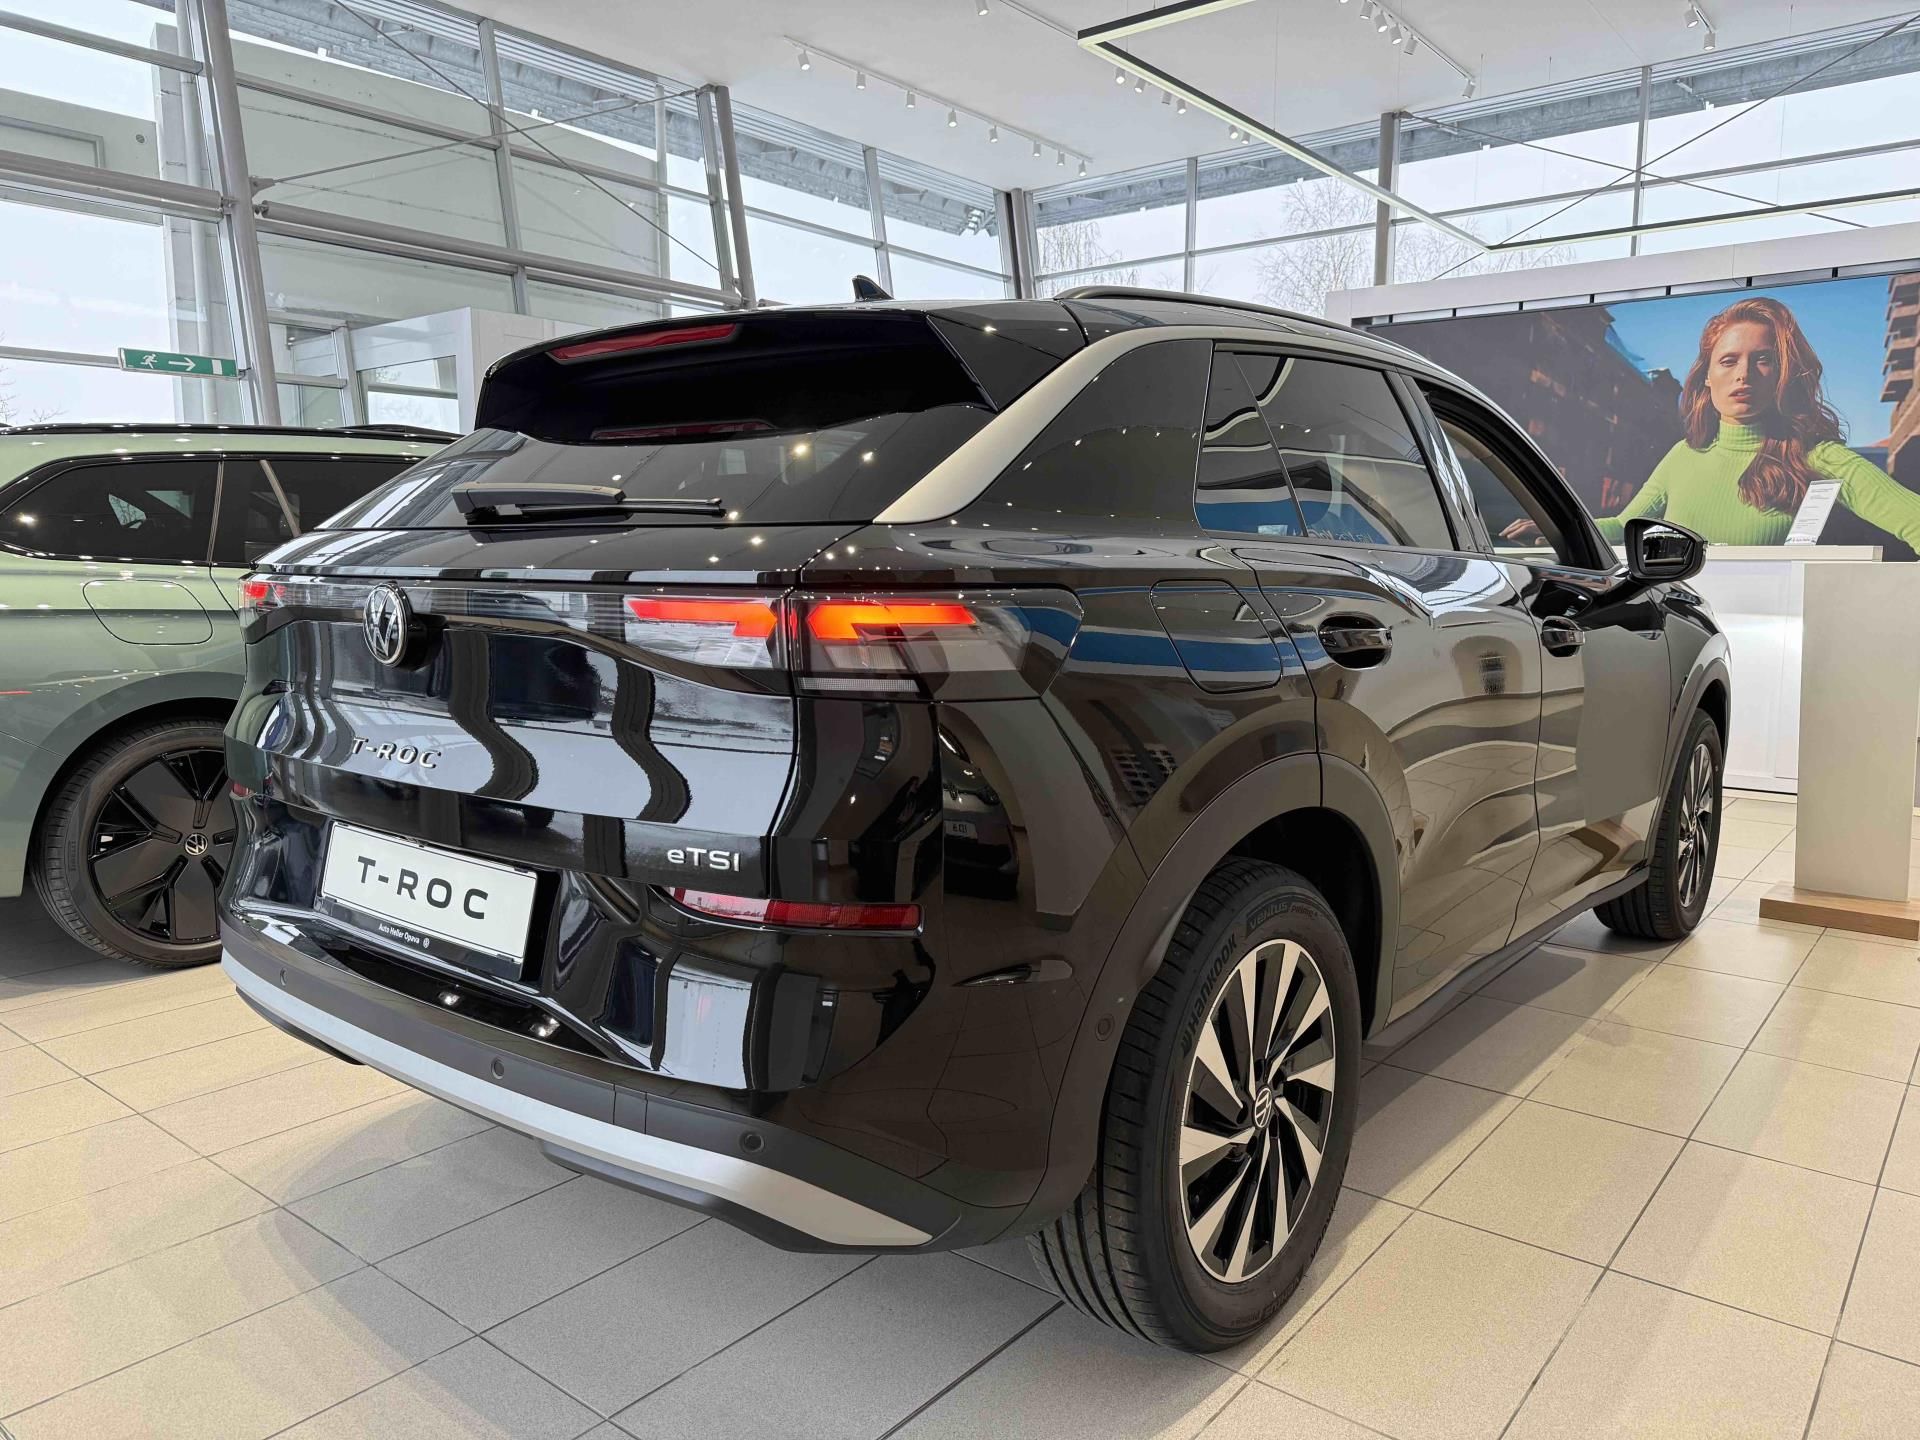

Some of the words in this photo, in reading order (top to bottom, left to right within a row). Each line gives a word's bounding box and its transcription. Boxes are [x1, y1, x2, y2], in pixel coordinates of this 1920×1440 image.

[352, 736, 442, 769] T-ROC
[667, 847, 740, 872] eTSI
[357, 855, 489, 920] T-ROC
